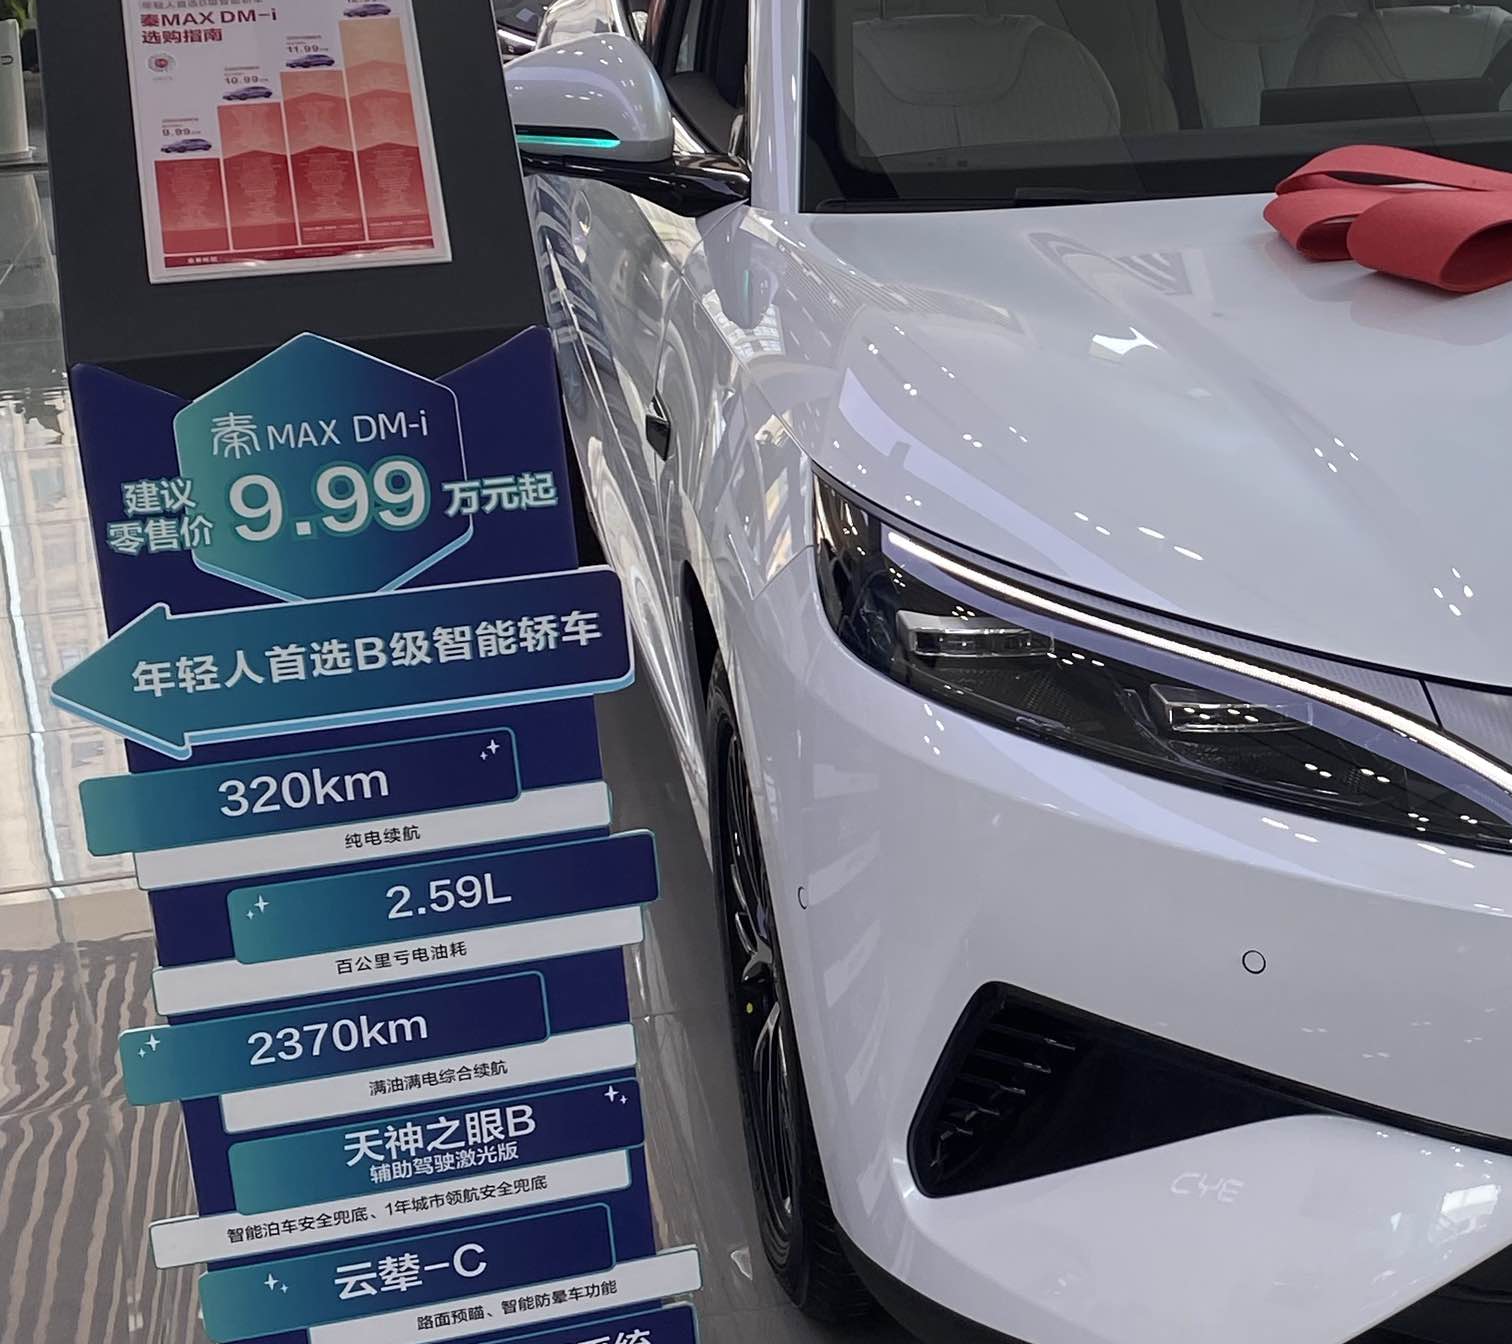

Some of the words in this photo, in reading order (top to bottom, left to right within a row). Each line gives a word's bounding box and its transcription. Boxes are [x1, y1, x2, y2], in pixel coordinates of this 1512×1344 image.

[142, 28, 223, 44] 选购指南
[354, 408, 429, 444] DM-i
[123, 477, 197, 514] 建议
[227, 458, 428, 542] 9.99
[442, 472, 558, 517] 万元起
[106, 513, 215, 556] 零售价
[131, 609, 602, 699] 年轻人首选B级智能轿车
[216, 766, 390, 818] 320km
[343, 824, 422, 850] 纯电续航
[385, 872, 512, 920] 2.59L
[335, 941, 468, 976] 百公里亏电油耗
[246, 1010, 429, 1068] 2370km
[368, 1059, 509, 1098] 满油满电综合续航
[343, 1103, 537, 1167] 天神之眼B
[369, 1142, 519, 1185] 辅助驾驶激光版
[416, 1280, 618, 1332] 路面预瞄、智能防晕车功能
